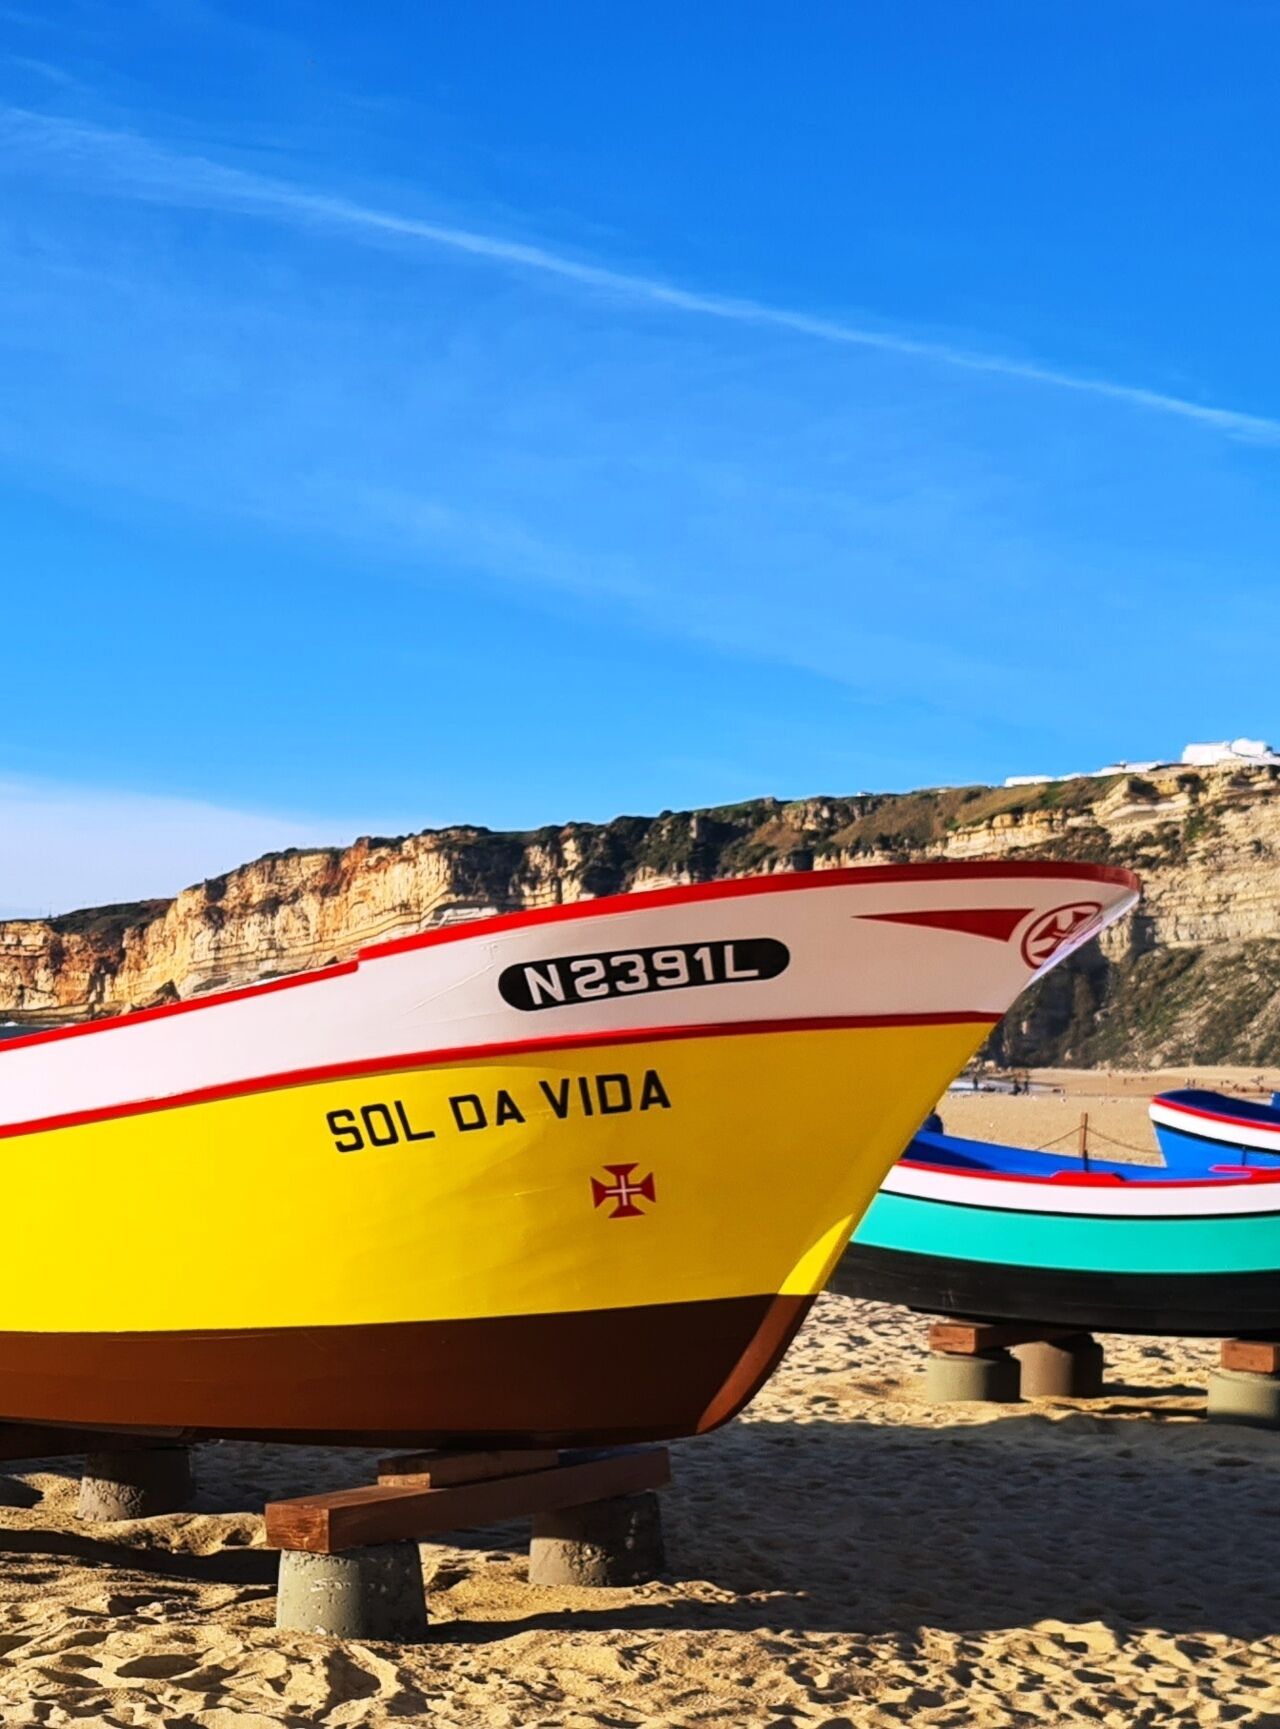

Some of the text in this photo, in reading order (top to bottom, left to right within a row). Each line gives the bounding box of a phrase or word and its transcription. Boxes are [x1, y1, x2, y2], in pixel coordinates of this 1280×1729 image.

[523, 944, 759, 1006] N2391L
[326, 1070, 671, 1153] SOL DA VIDA
